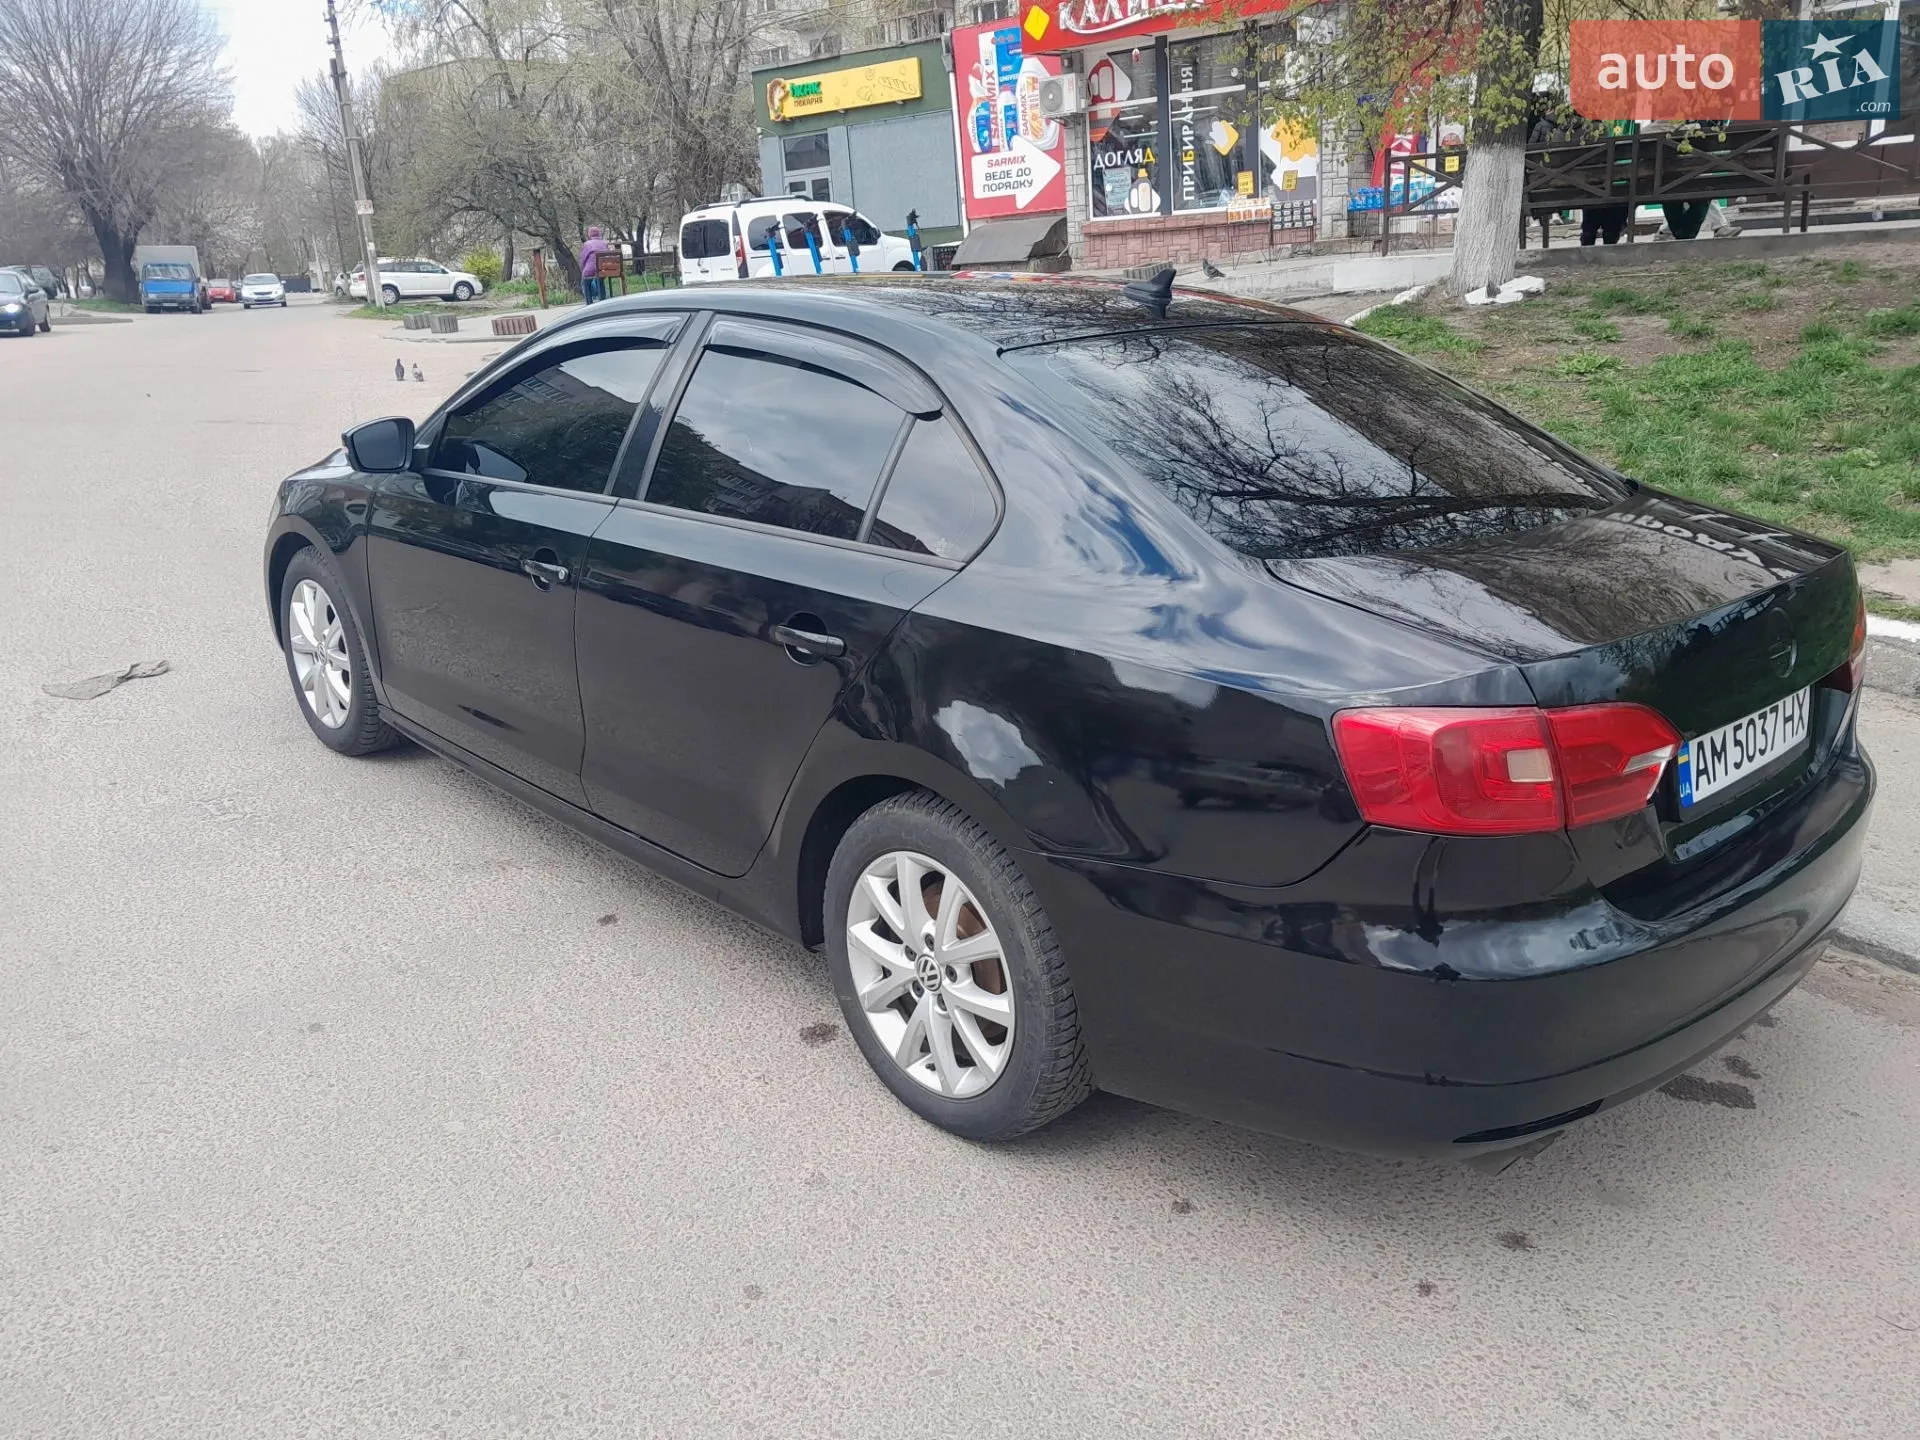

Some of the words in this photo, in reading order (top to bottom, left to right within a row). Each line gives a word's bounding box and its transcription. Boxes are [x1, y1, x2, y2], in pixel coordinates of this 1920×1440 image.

[1021, 93, 1029, 136] SARMIX
[1181, 66, 1194, 200] ПРИБИРАННЯ
[987, 155, 1026, 168] SARMIX
[1094, 148, 1155, 170] ДОГЛЯД
[985, 169, 1012, 181] ВЕДЕ
[1016, 167, 1031, 177] ДО
[983, 179, 1033, 192] ПОРЯДКУ
[1695, 729, 1728, 792] AM
[1733, 704, 1779, 770] 5037
[1783, 688, 1807, 744] HX
[1679, 781, 1692, 798] UA
